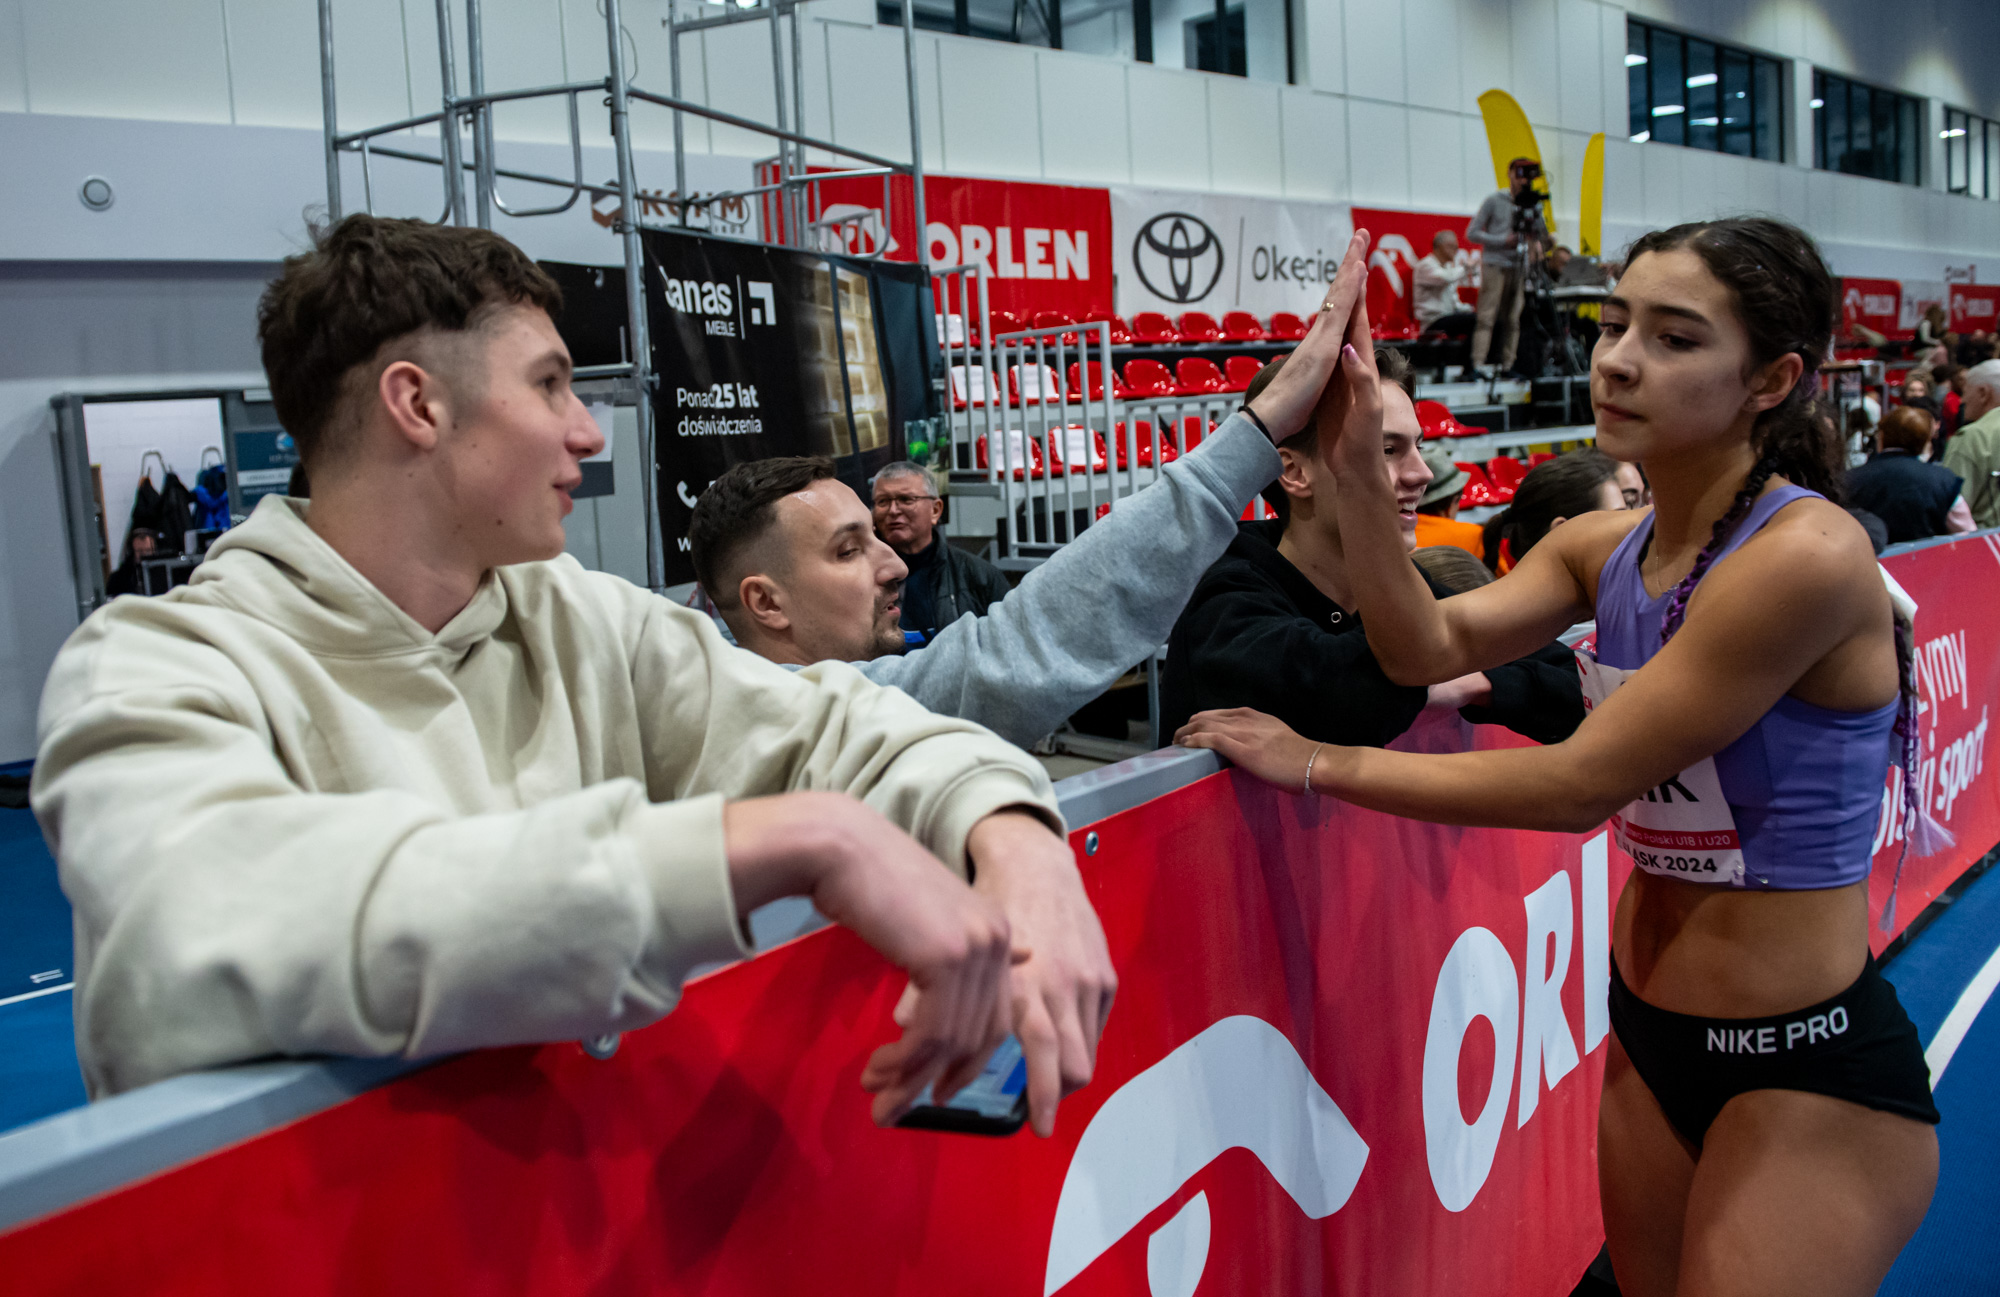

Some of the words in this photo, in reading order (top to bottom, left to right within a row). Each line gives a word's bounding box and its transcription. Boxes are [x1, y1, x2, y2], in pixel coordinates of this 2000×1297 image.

[926, 221, 1090, 280] ORLEN
[1252, 245, 1338, 290] Okęcie
[711, 383, 735, 409] 25
[736, 382, 760, 409] lat
[677, 414, 763, 437] doświadczenia
[1936, 704, 1988, 822] sport
[1644, 832, 1675, 845] Polski
[1676, 836, 1696, 847] U18
[1698, 836, 1703, 846] i
[1705, 835, 1731, 846] U20
[1664, 856, 1718, 873] 2024
[1707, 1027, 1777, 1054] NIKE
[1785, 1006, 1849, 1050] PRO
